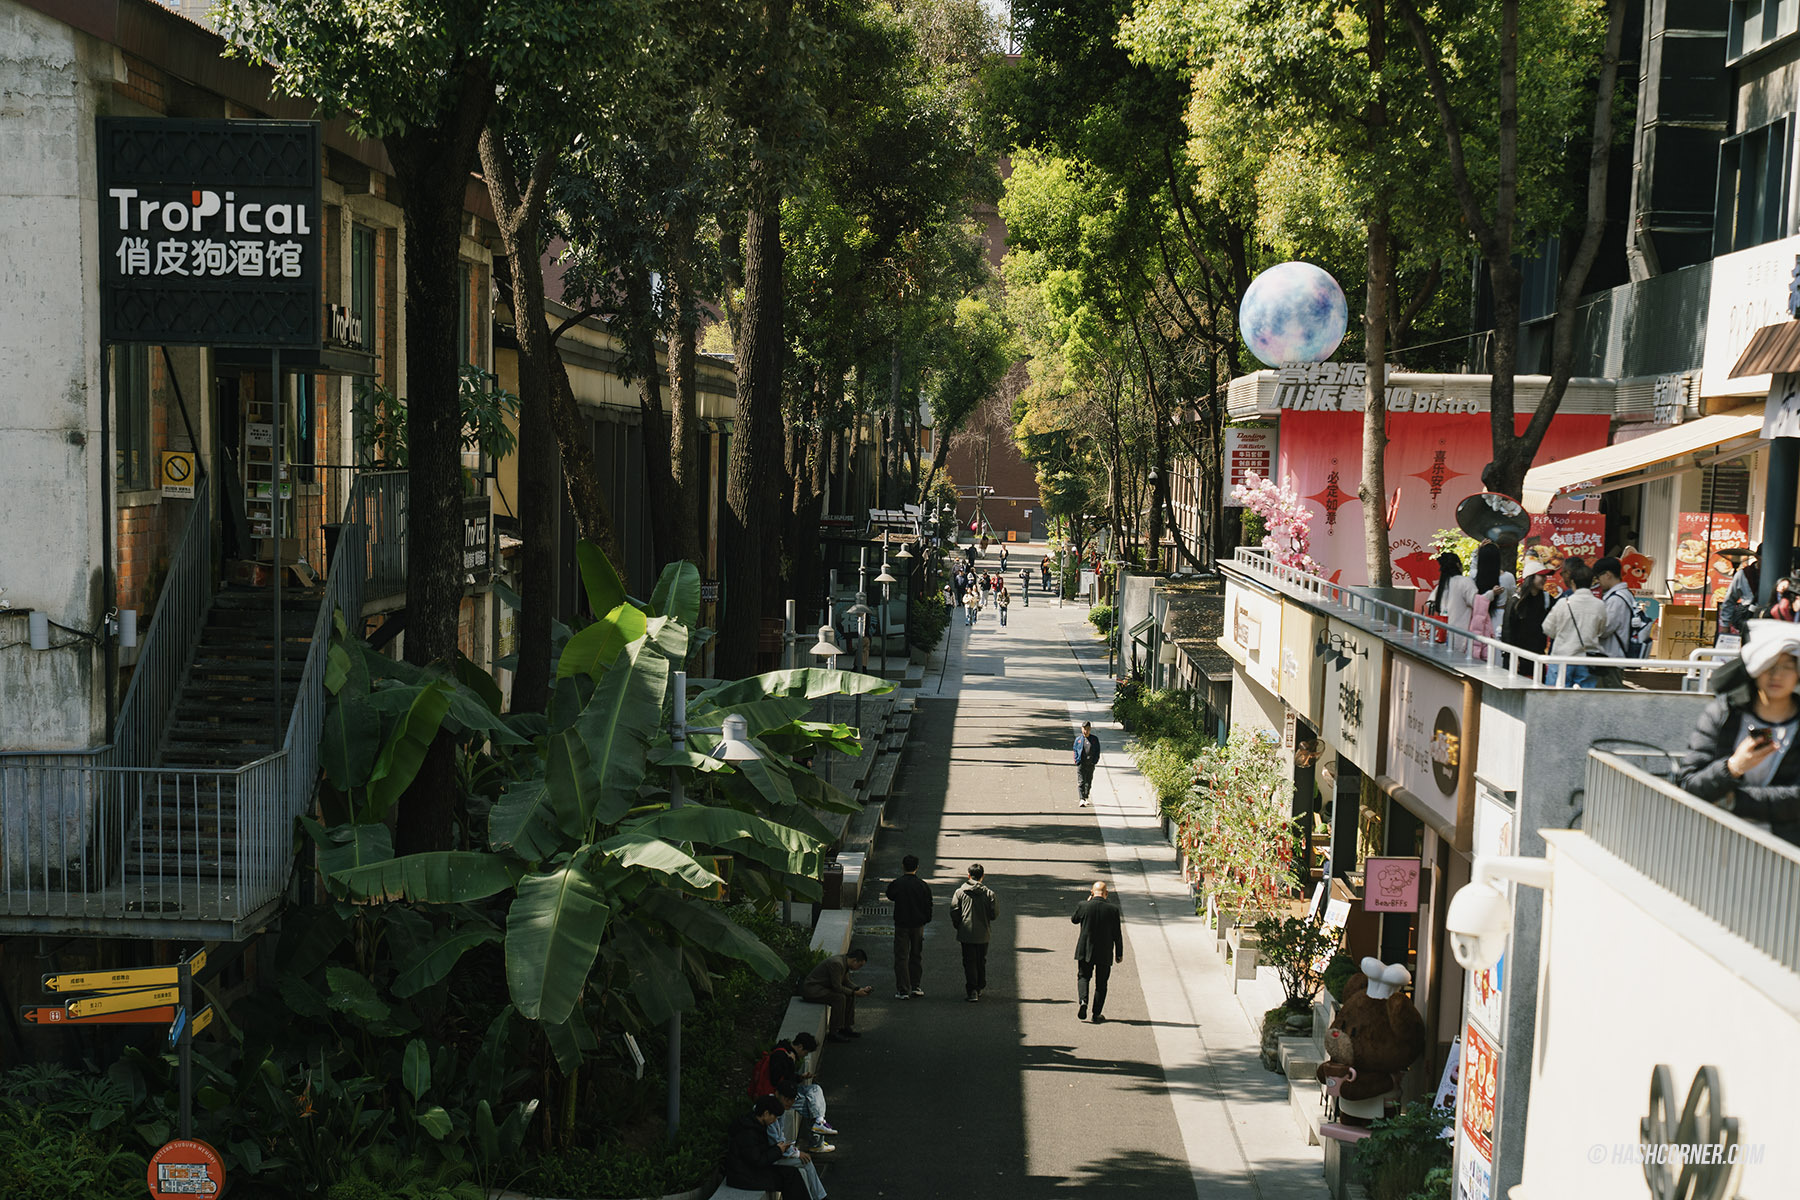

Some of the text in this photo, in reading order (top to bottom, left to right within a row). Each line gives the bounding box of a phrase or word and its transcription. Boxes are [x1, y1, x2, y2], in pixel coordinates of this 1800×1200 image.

[115, 236, 302, 278] 俏皮狗酒馆
[1412, 392, 1482, 415] Bistro
[1429, 450, 1447, 500] 喜乐安宁
[1325, 470, 1340, 525] 必定如意
[1550, 531, 1603, 547] 创意菜人气
